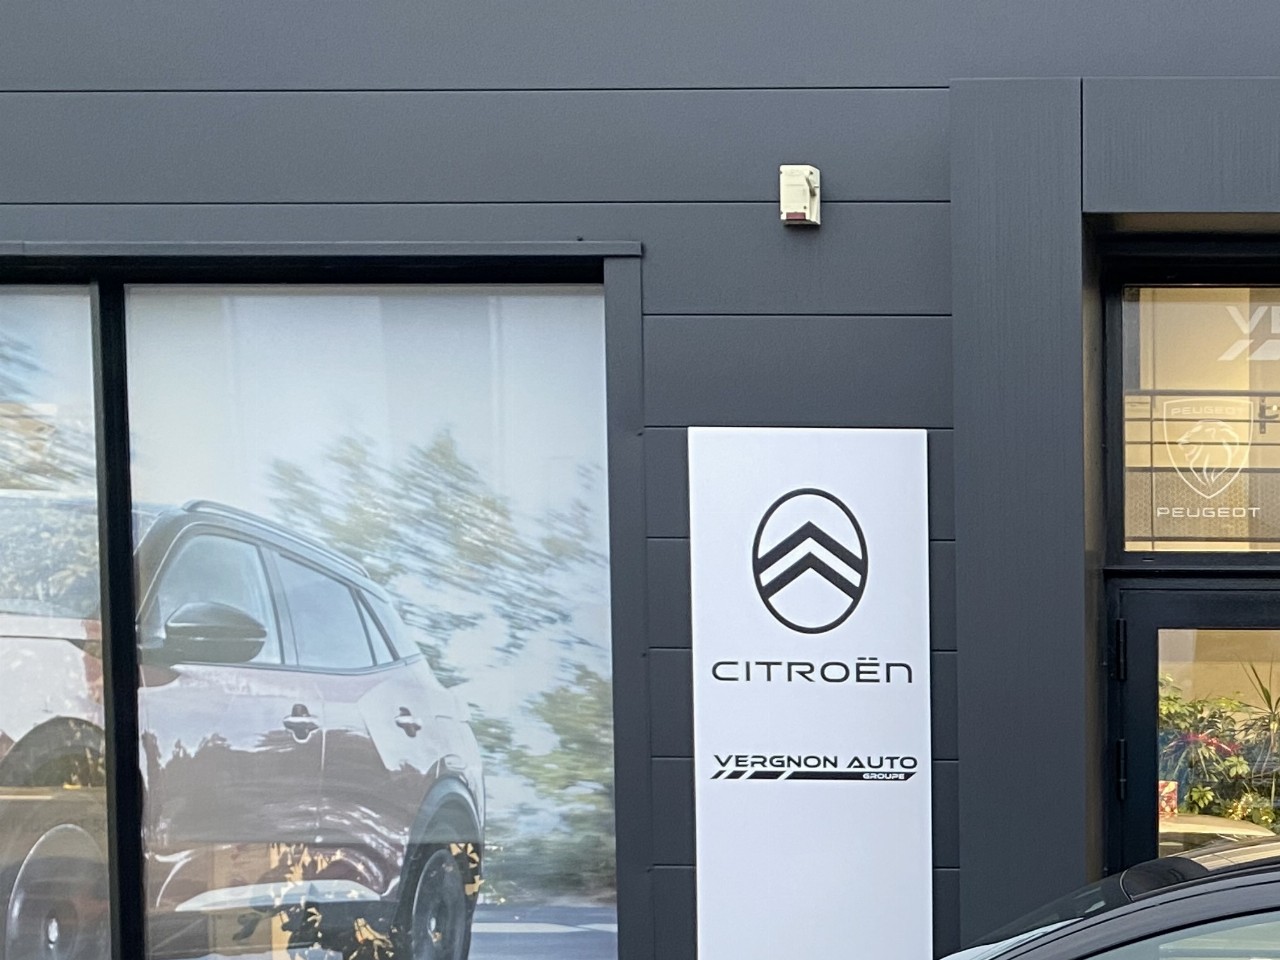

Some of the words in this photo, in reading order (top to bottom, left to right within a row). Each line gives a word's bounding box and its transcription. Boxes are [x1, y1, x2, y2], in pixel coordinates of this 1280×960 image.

[1171, 405, 1246, 416] PEUGEOT
[1156, 507, 1261, 518] PEUGEOT
[713, 755, 838, 768] VERGNON
[846, 755, 918, 769] AUTO
